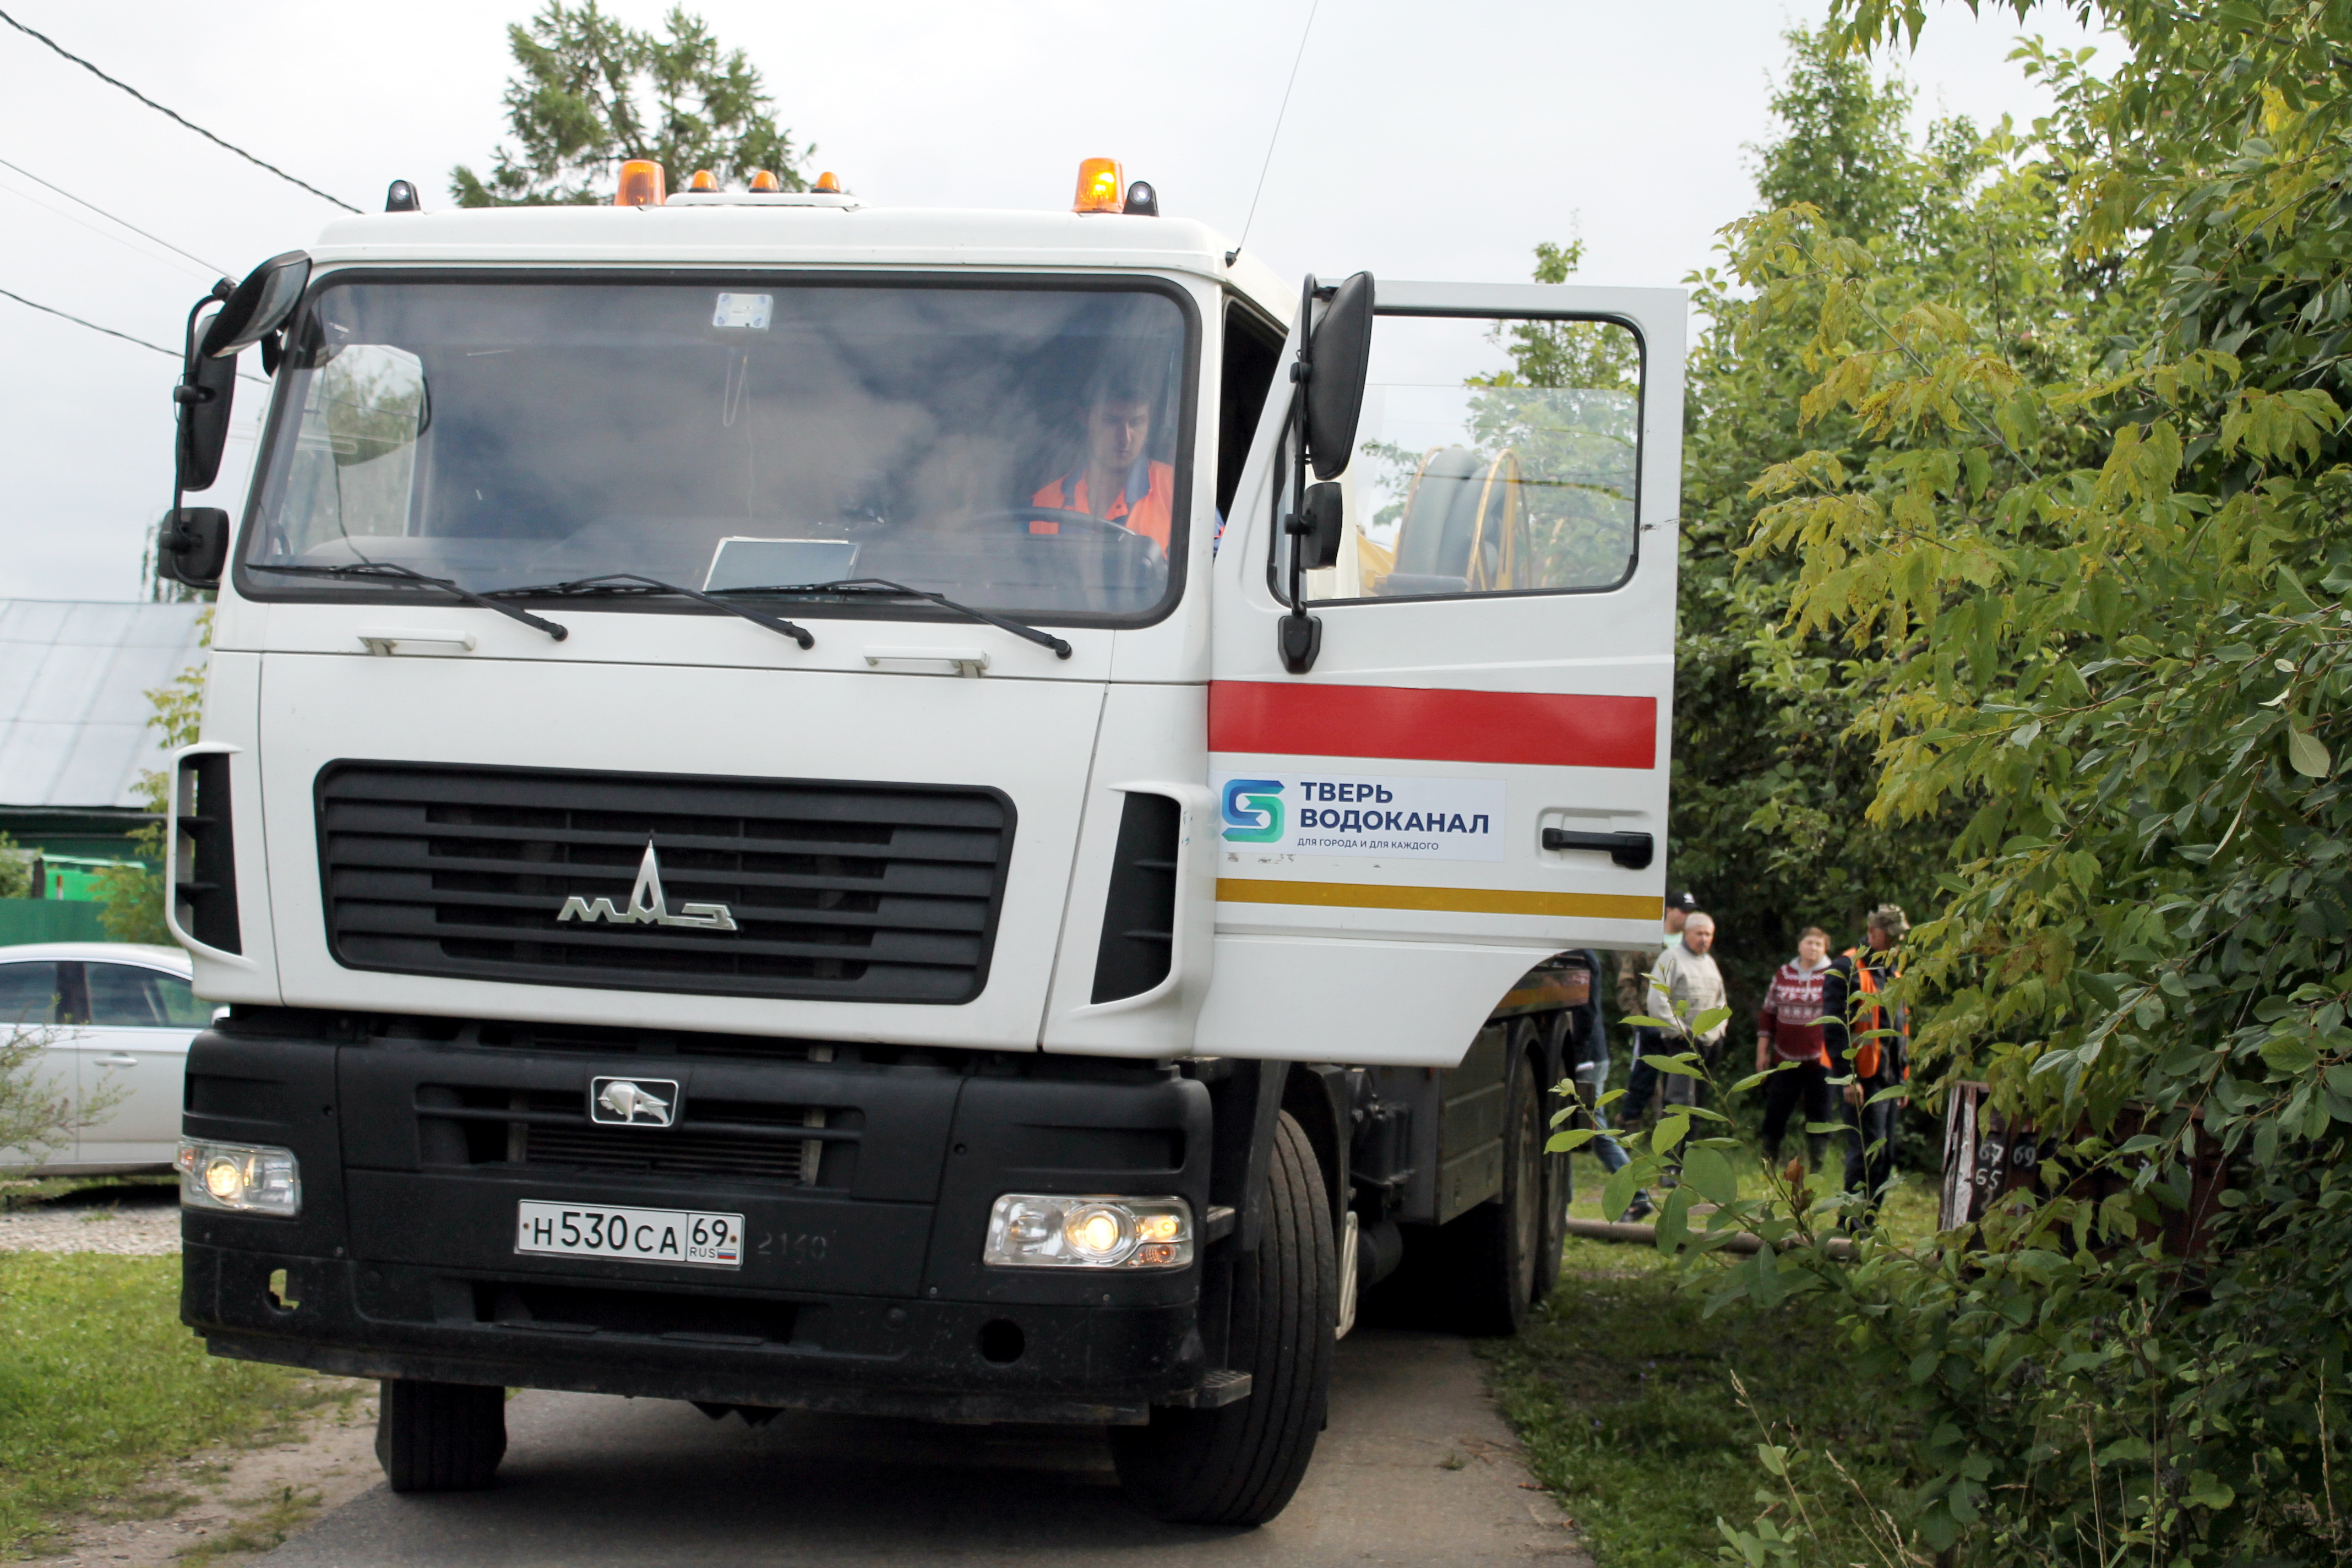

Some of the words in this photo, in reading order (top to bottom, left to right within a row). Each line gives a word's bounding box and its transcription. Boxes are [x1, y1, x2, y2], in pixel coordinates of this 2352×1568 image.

[1300, 782, 1393, 804] ТВЕРЬ
[1300, 808, 1489, 834] ВОДОКАНАЛ
[1297, 838, 1317, 847] ДЛЯ
[1319, 839, 1358, 848] ГОРОДА
[1369, 841, 1389, 849] ДЛЯ
[1391, 841, 1439, 851] КАЖДОГО
[2013, 1145, 2037, 1167] 69
[1975, 1168, 2003, 1190] 65
[692, 1218, 728, 1247] 69
[689, 1246, 716, 1259] RUS
